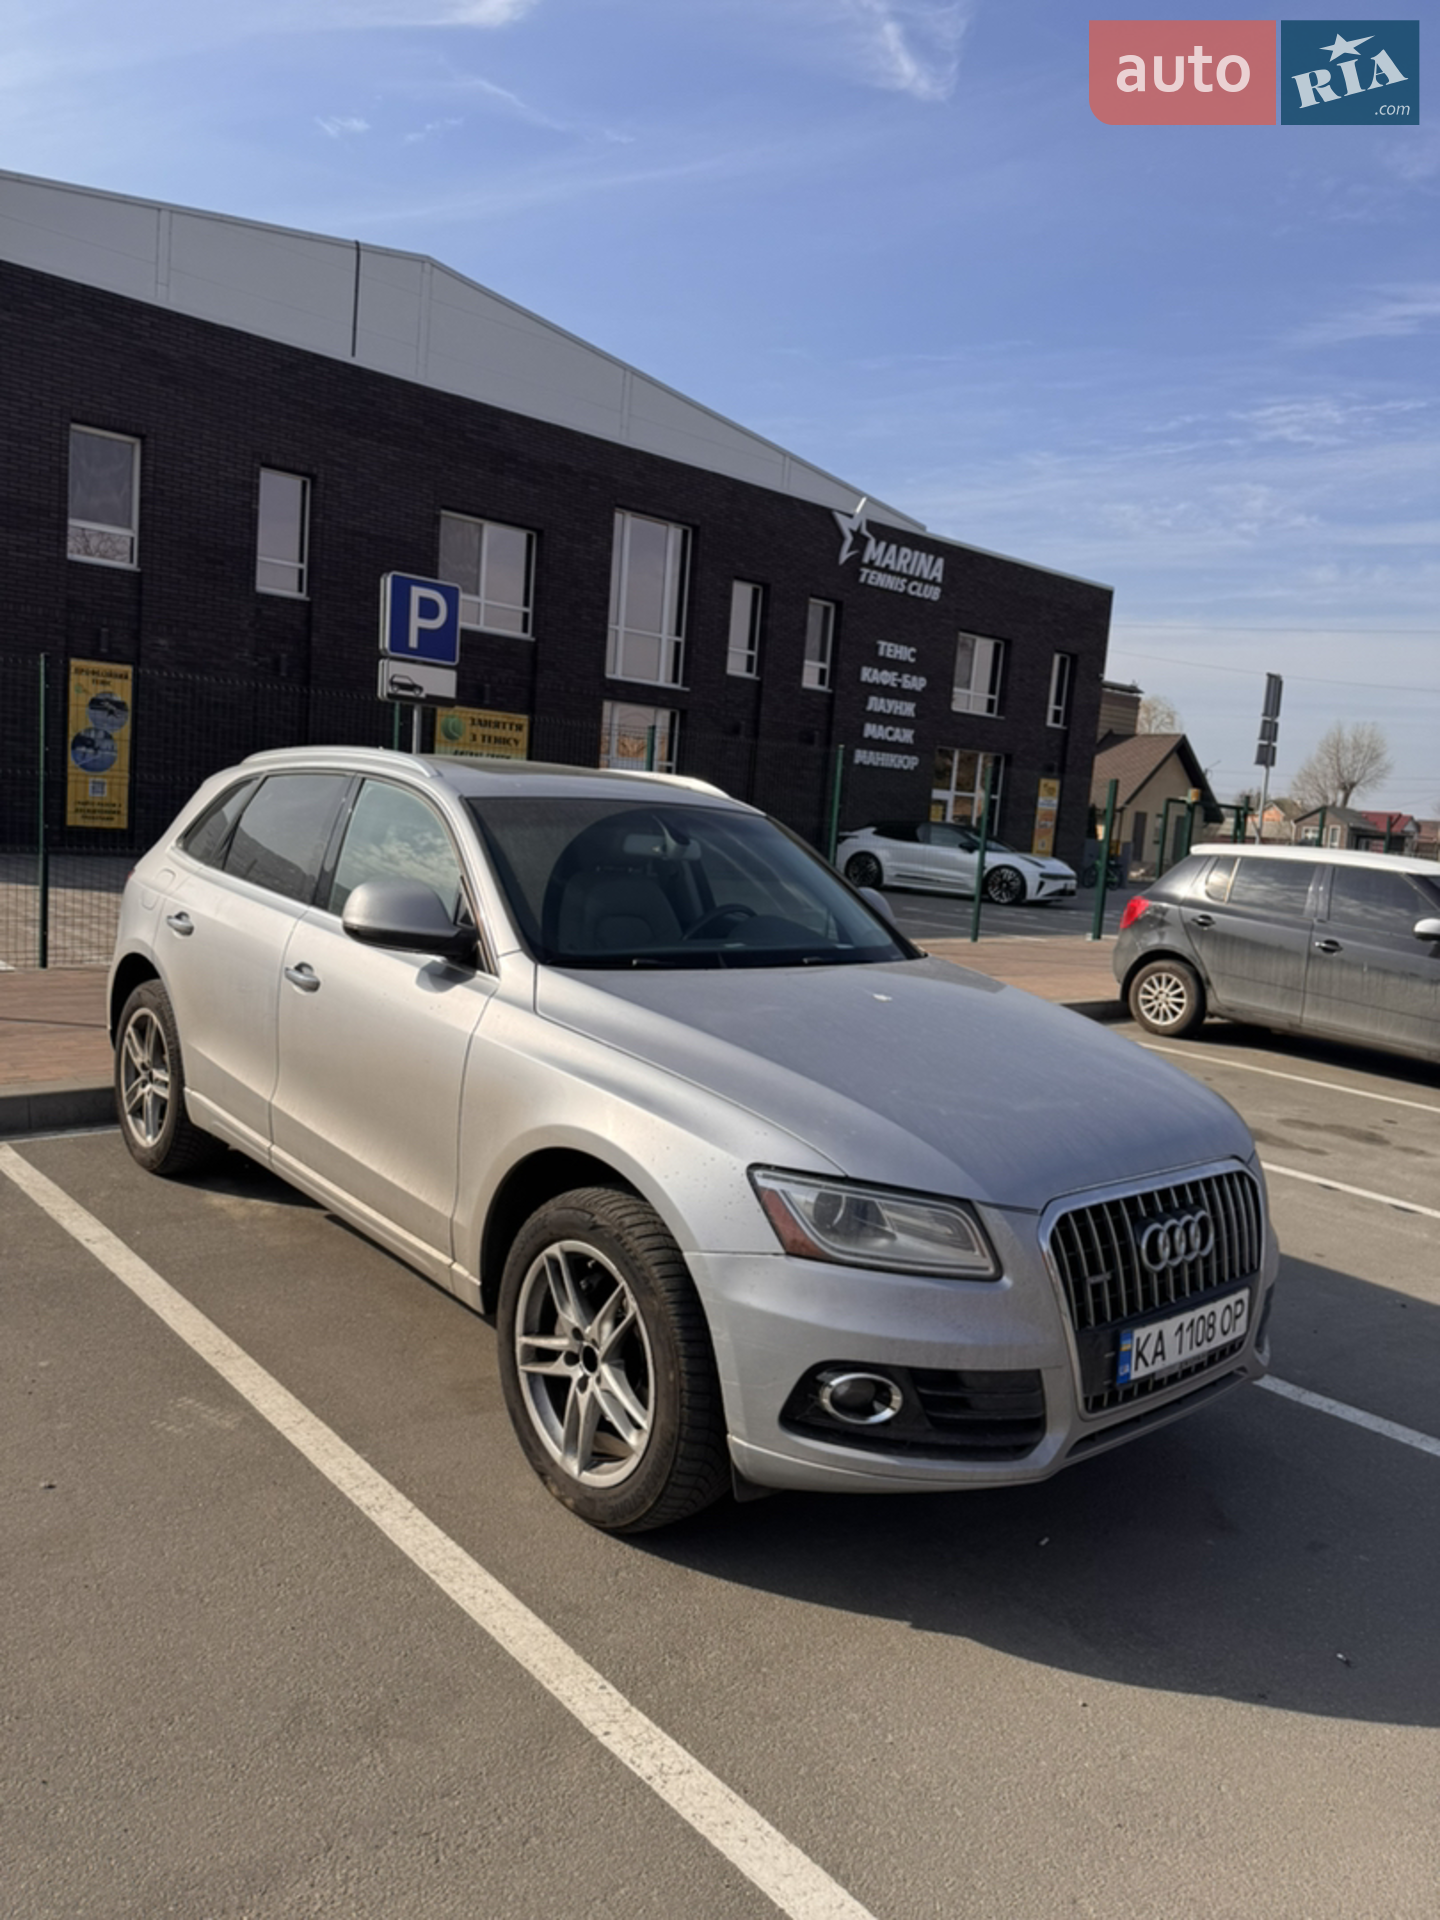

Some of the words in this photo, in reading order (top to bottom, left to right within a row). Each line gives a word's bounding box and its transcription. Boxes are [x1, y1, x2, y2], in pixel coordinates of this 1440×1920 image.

[862, 540, 944, 583] MARINA
[859, 567, 907, 593] TENNIS
[907, 580, 942, 602] CLUB
[408, 585, 448, 650] P
[876, 640, 917, 663] ТЕНІС
[860, 666, 927, 692] КАФЕ-БАР
[866, 696, 916, 717] ЛАУНЖ
[470, 716, 524, 732] ЗАНЯТТЯ
[863, 722, 915, 744] МАСАЖ
[853, 749, 920, 770] МАНІКЮР
[1174, 1311, 1217, 1355] 1108
